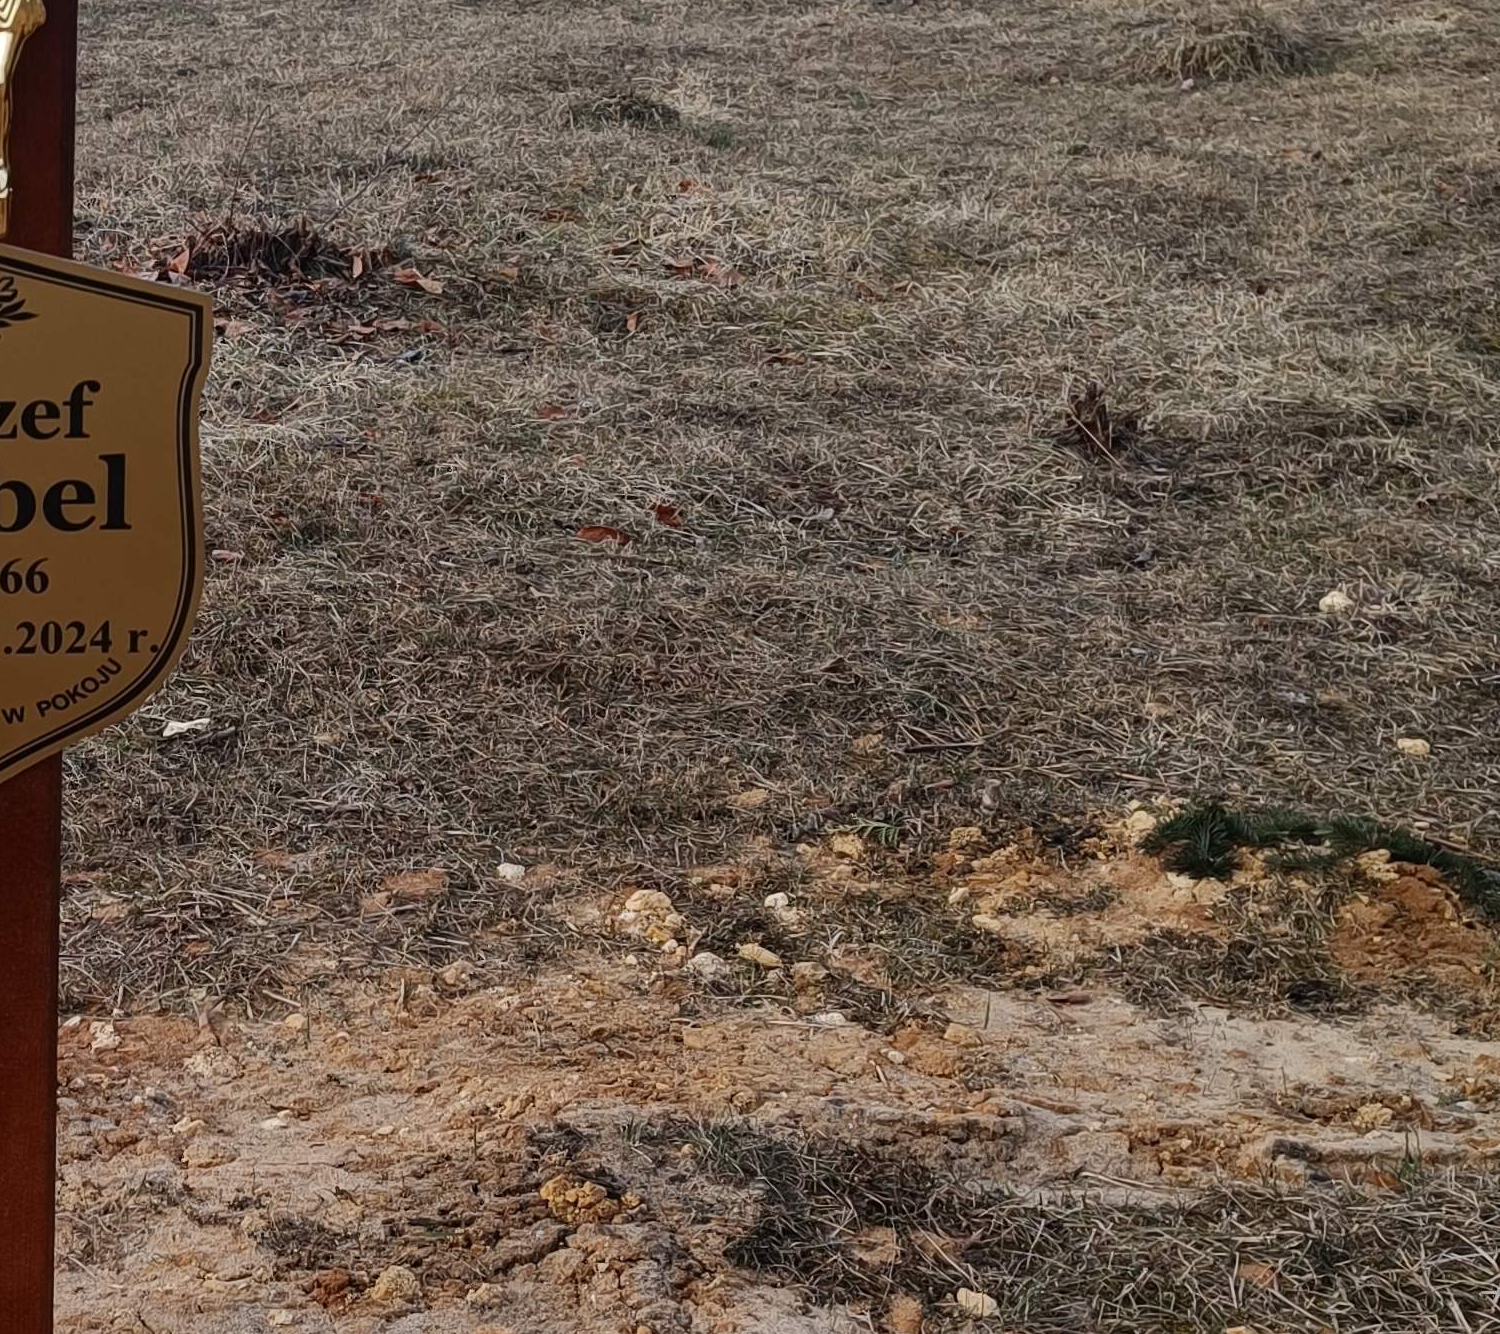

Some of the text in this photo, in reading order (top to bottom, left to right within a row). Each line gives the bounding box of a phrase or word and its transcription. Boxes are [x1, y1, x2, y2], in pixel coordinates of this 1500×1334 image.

[0, 558, 49, 594] 66
[128, 630, 161, 657] r.
[1, 706, 24, 724] W
[36, 657, 123, 717] POKOJU
